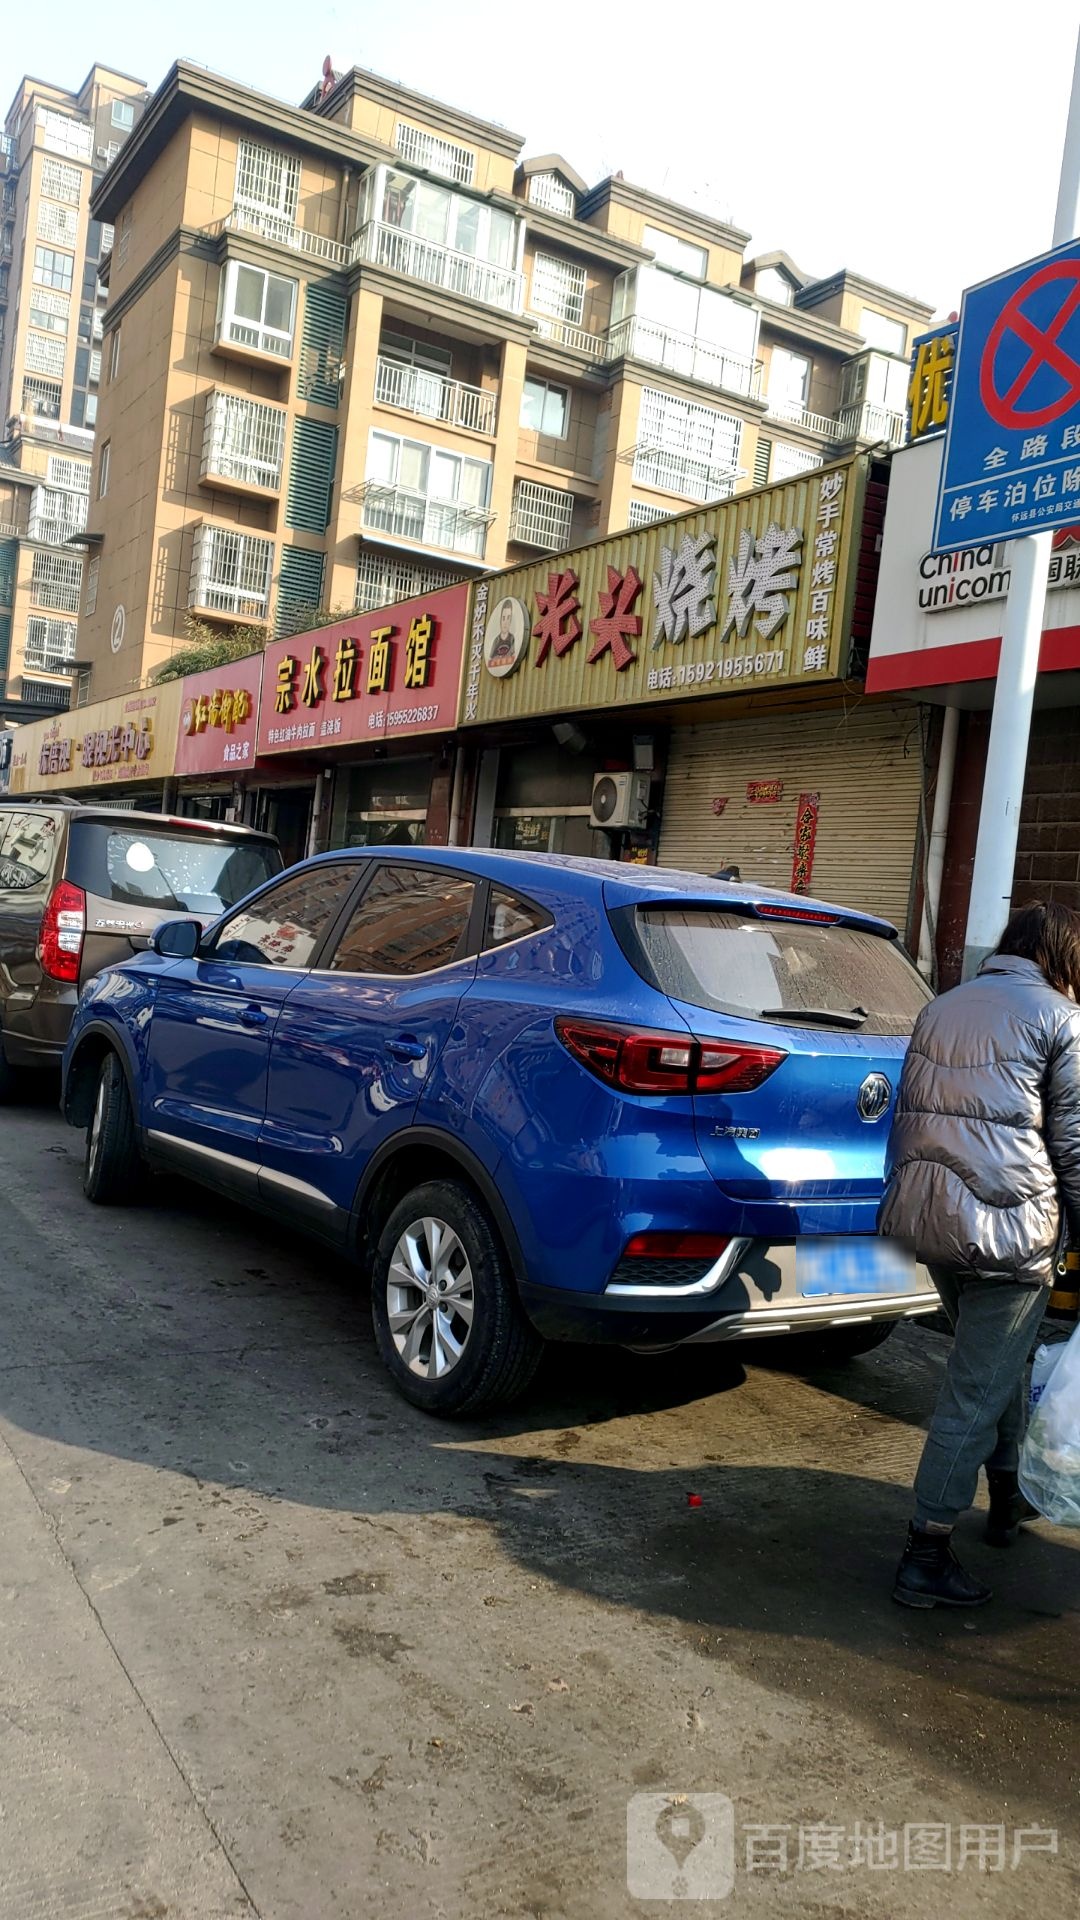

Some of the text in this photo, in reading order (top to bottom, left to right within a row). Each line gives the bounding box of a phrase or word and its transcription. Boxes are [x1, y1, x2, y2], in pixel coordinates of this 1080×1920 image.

[908, 336, 955, 438] 优
[803, 472, 843, 673] 妙手常烤百味鲜
[918, 569, 1011, 608] unicom
[274, 613, 435, 713] 宗水拉面馆
[464, 582, 489, 721] 金炉不灭千年火
[647, 651, 784, 690] 电话:15921955671
[223, 741, 250, 762] 食品之家
